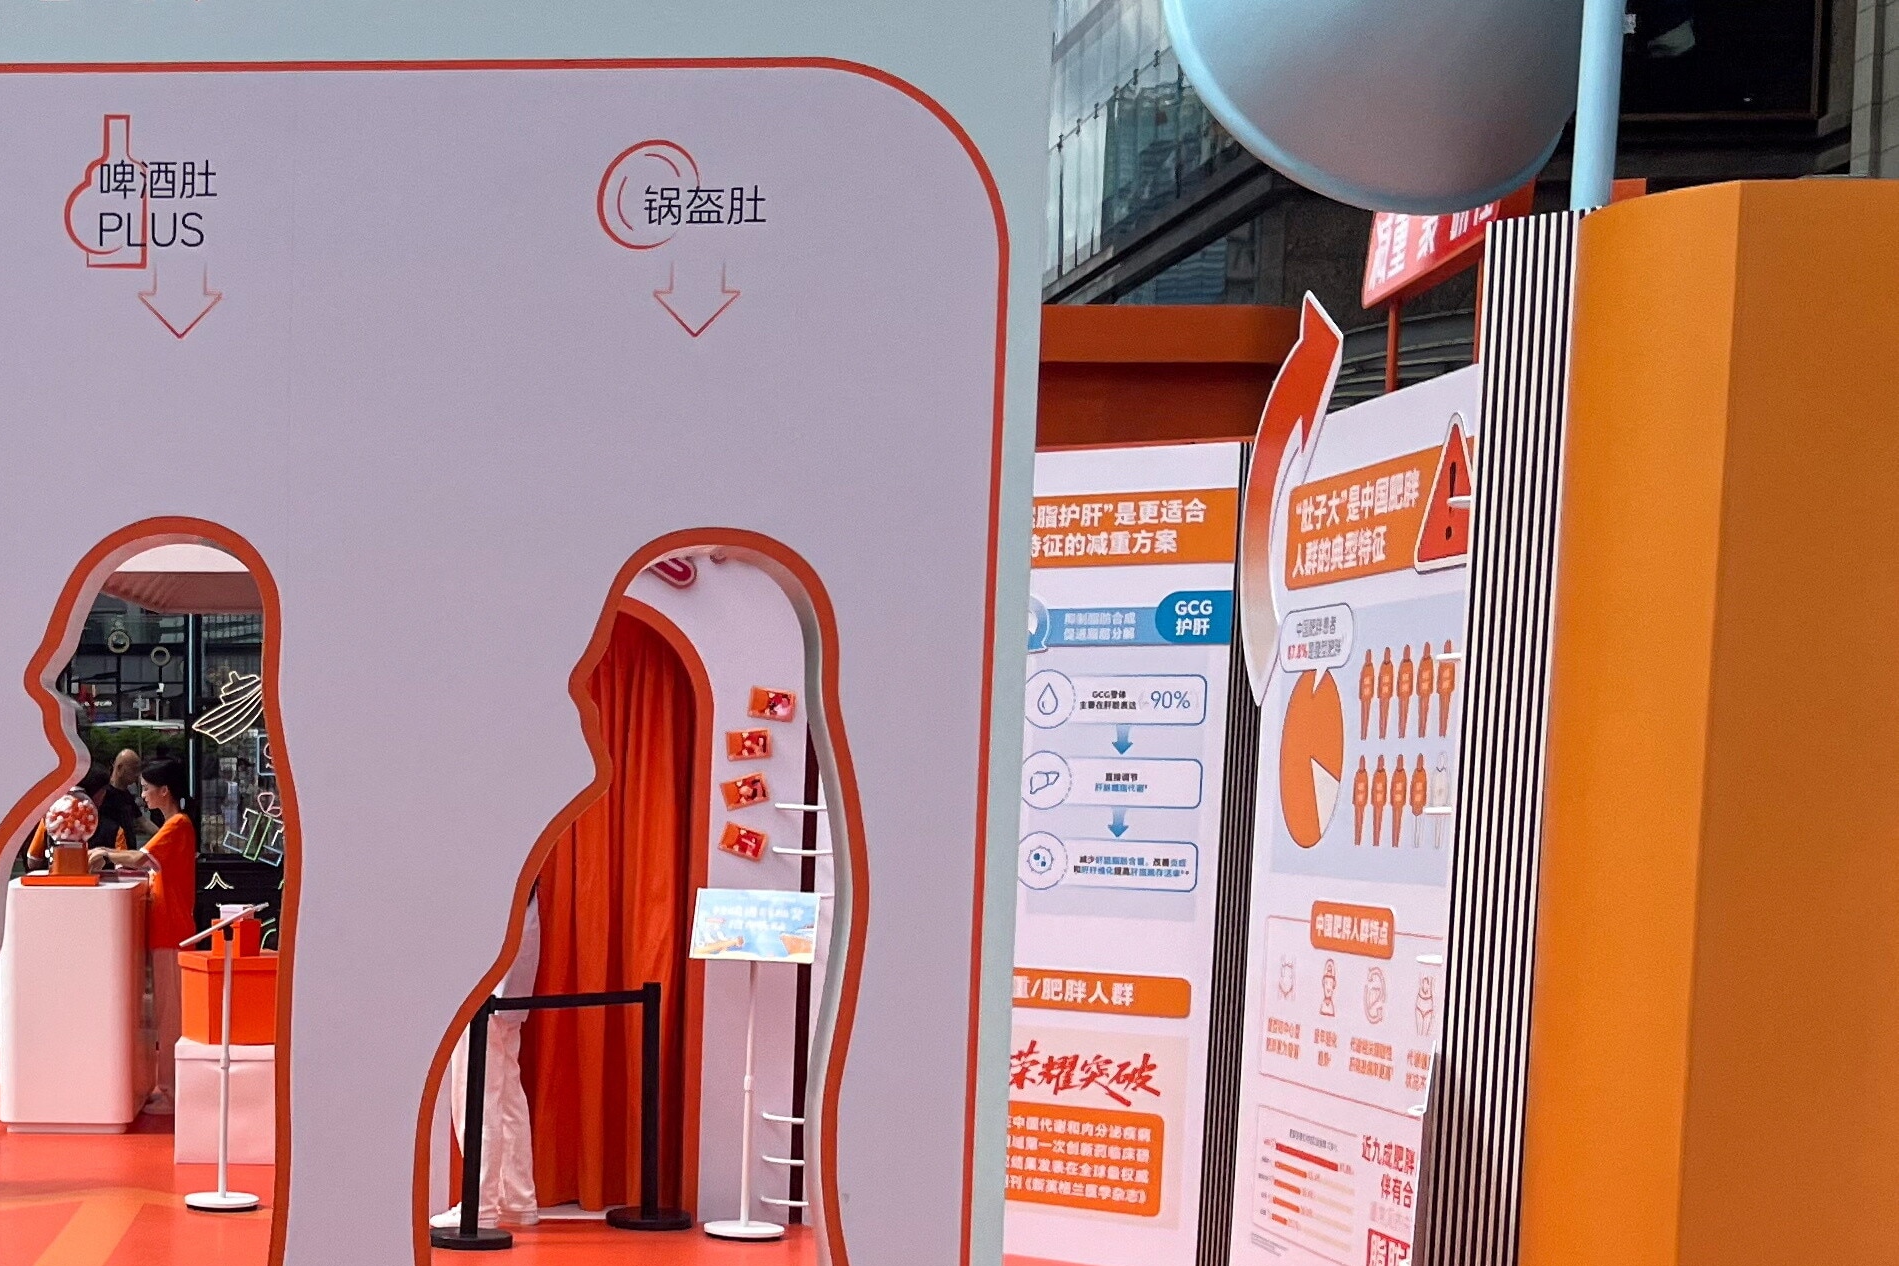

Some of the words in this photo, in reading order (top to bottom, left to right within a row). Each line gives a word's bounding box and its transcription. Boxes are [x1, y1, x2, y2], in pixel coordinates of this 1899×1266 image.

[99, 158, 218, 201] 啤酒肚
[642, 184, 768, 226] 锅盔肚
[99, 211, 205, 249] PLUS
[1033, 497, 1207, 529] 脂护肝”是更适合
[1174, 600, 1213, 616] GCG
[1175, 618, 1210, 636] 护肝
